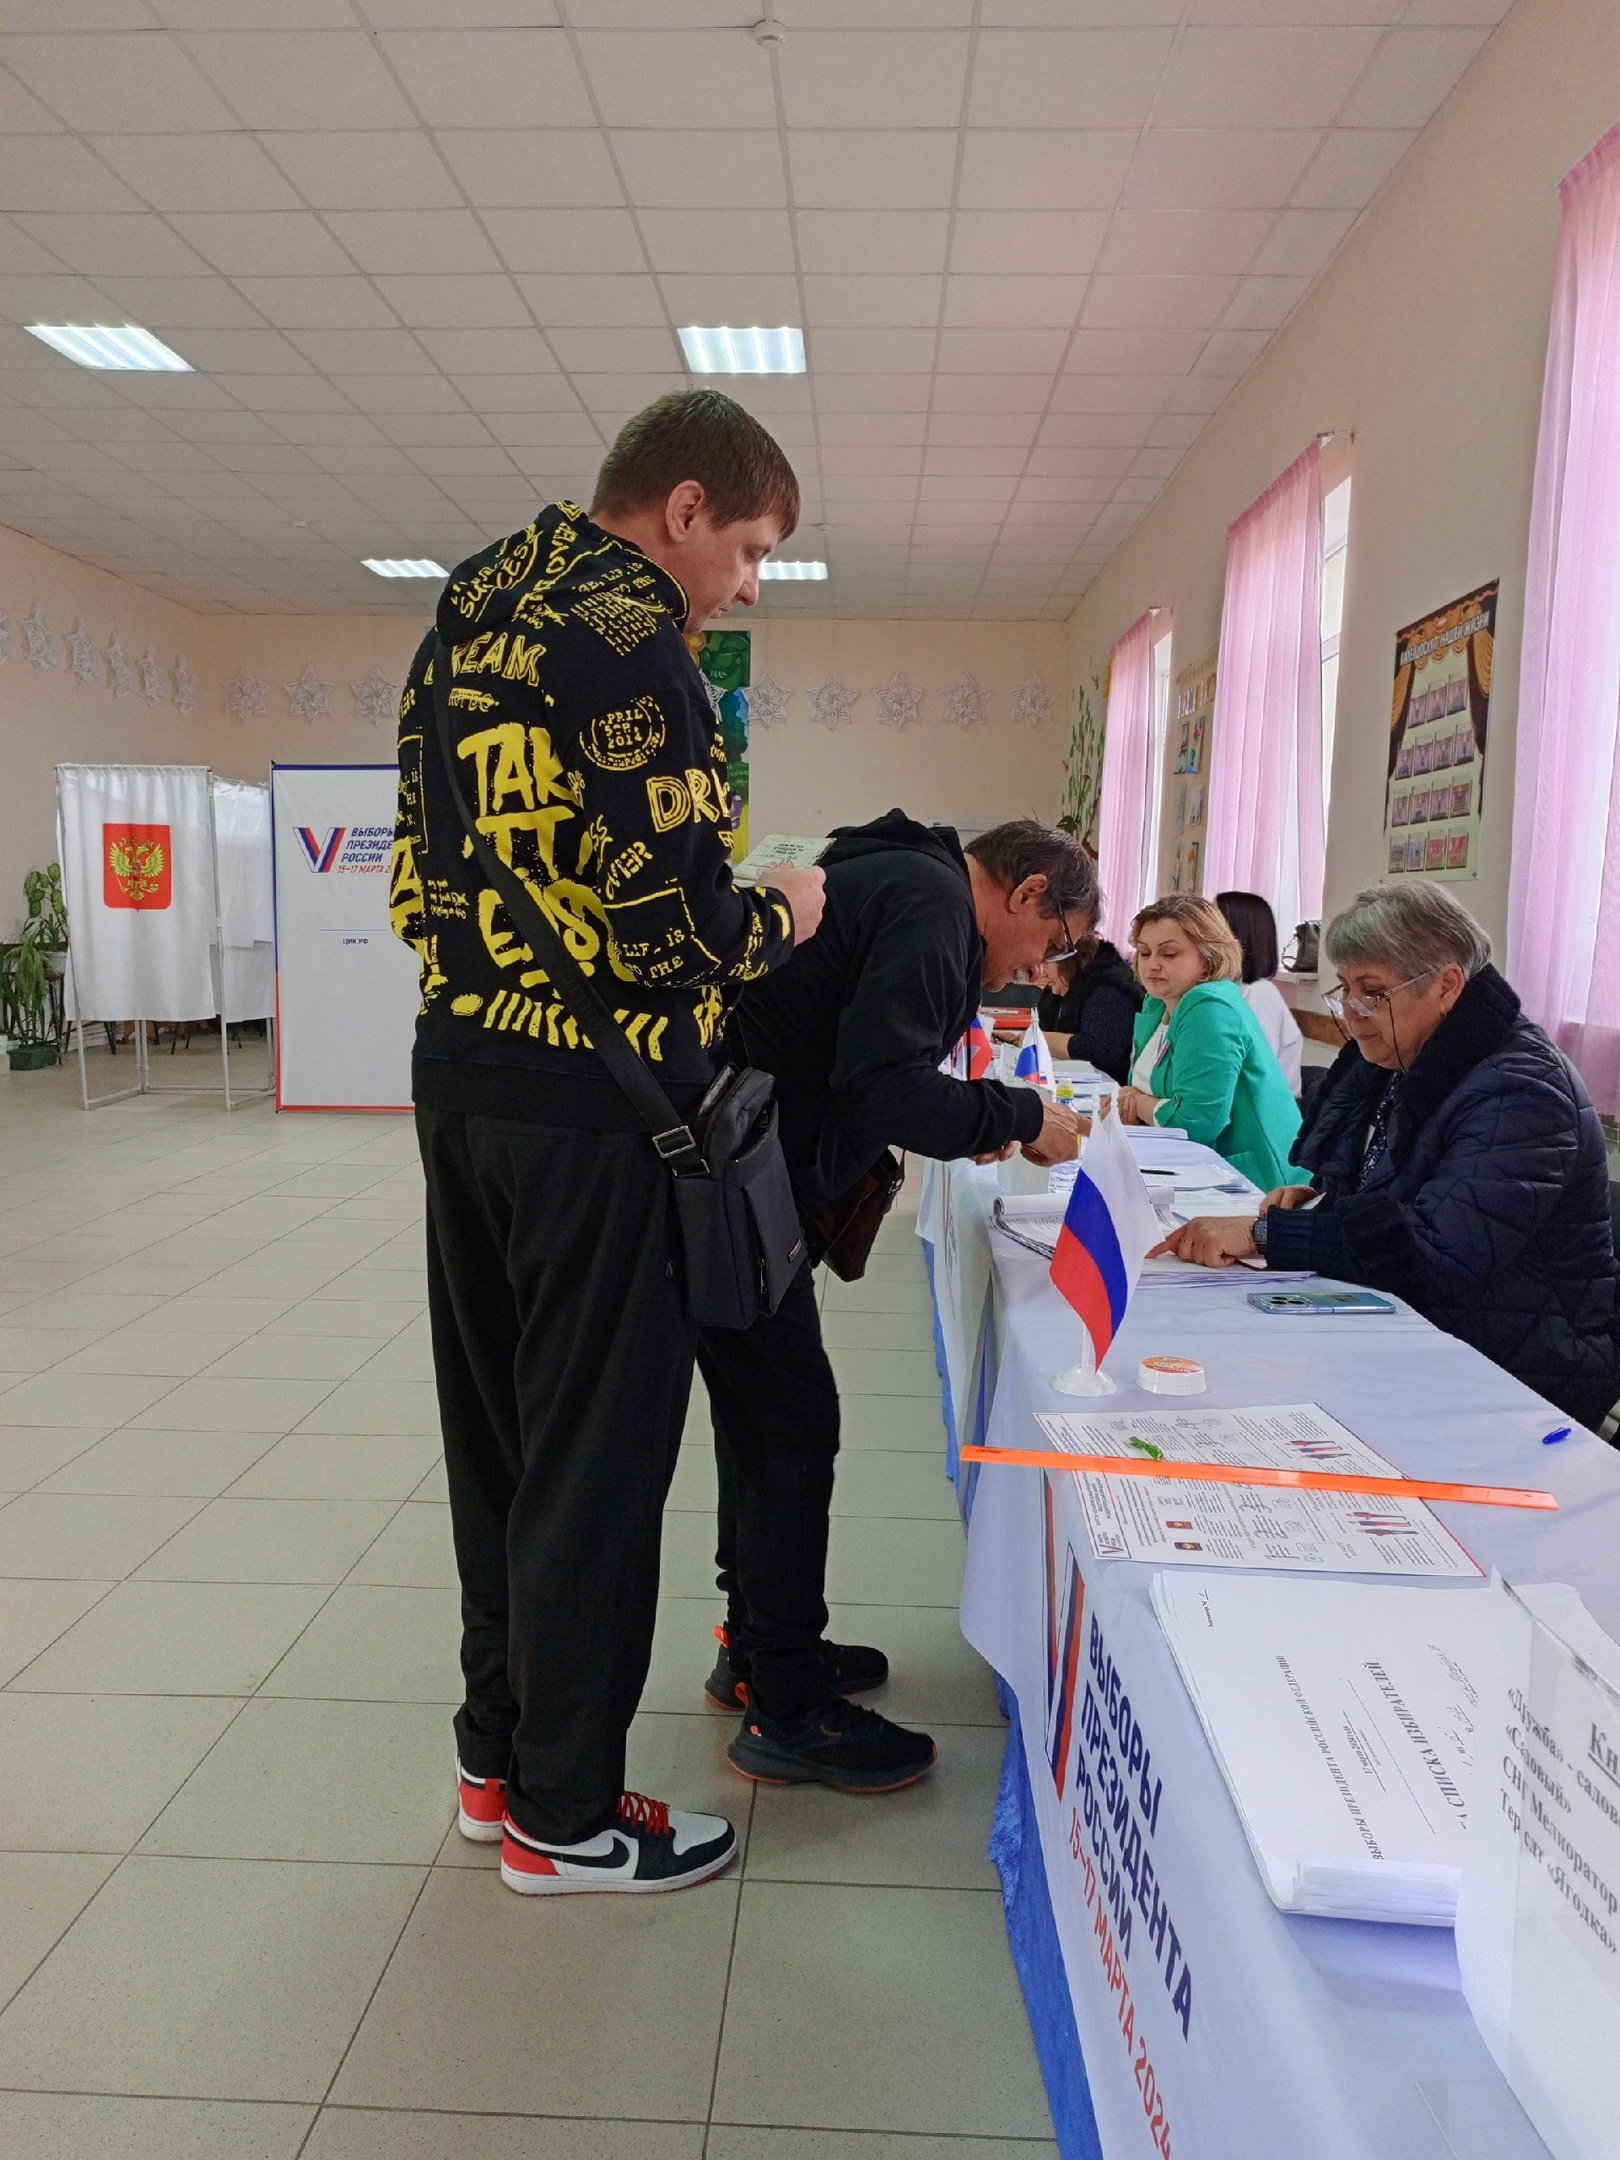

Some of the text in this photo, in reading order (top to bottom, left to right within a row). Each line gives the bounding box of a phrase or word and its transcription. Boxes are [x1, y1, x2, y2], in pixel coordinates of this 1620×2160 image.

[457, 722, 582, 808] TAK
[341, 853, 383, 863] РОССИИ
[346, 840, 393, 850] ПРЕЗИДЕ
[359, 865, 383, 873] МАРТА
[1089, 1611, 1162, 1838] ВЫБОРЫ
[1362, 1661, 1429, 1744] ИЗБИРАТЕЛЕЙ
[1326, 1757, 1362, 1815] ПРЕЗИДЕНТА
[1419, 1748, 1466, 1808] СПИСКА
[1076, 1744, 1133, 1962] РОССИИ
[1082, 1679, 1193, 2043] ПРЕЗИДЕНТА
[1354, 1818, 1385, 1860] ВЫБОРЫ
[1500, 1787, 1520, 1834] Тер
[1547, 1862, 1617, 1953] «Ягодка»
[1530, 1790, 1618, 1915] Мелиоратор
[1093, 1894, 1135, 2057] МАРТА
